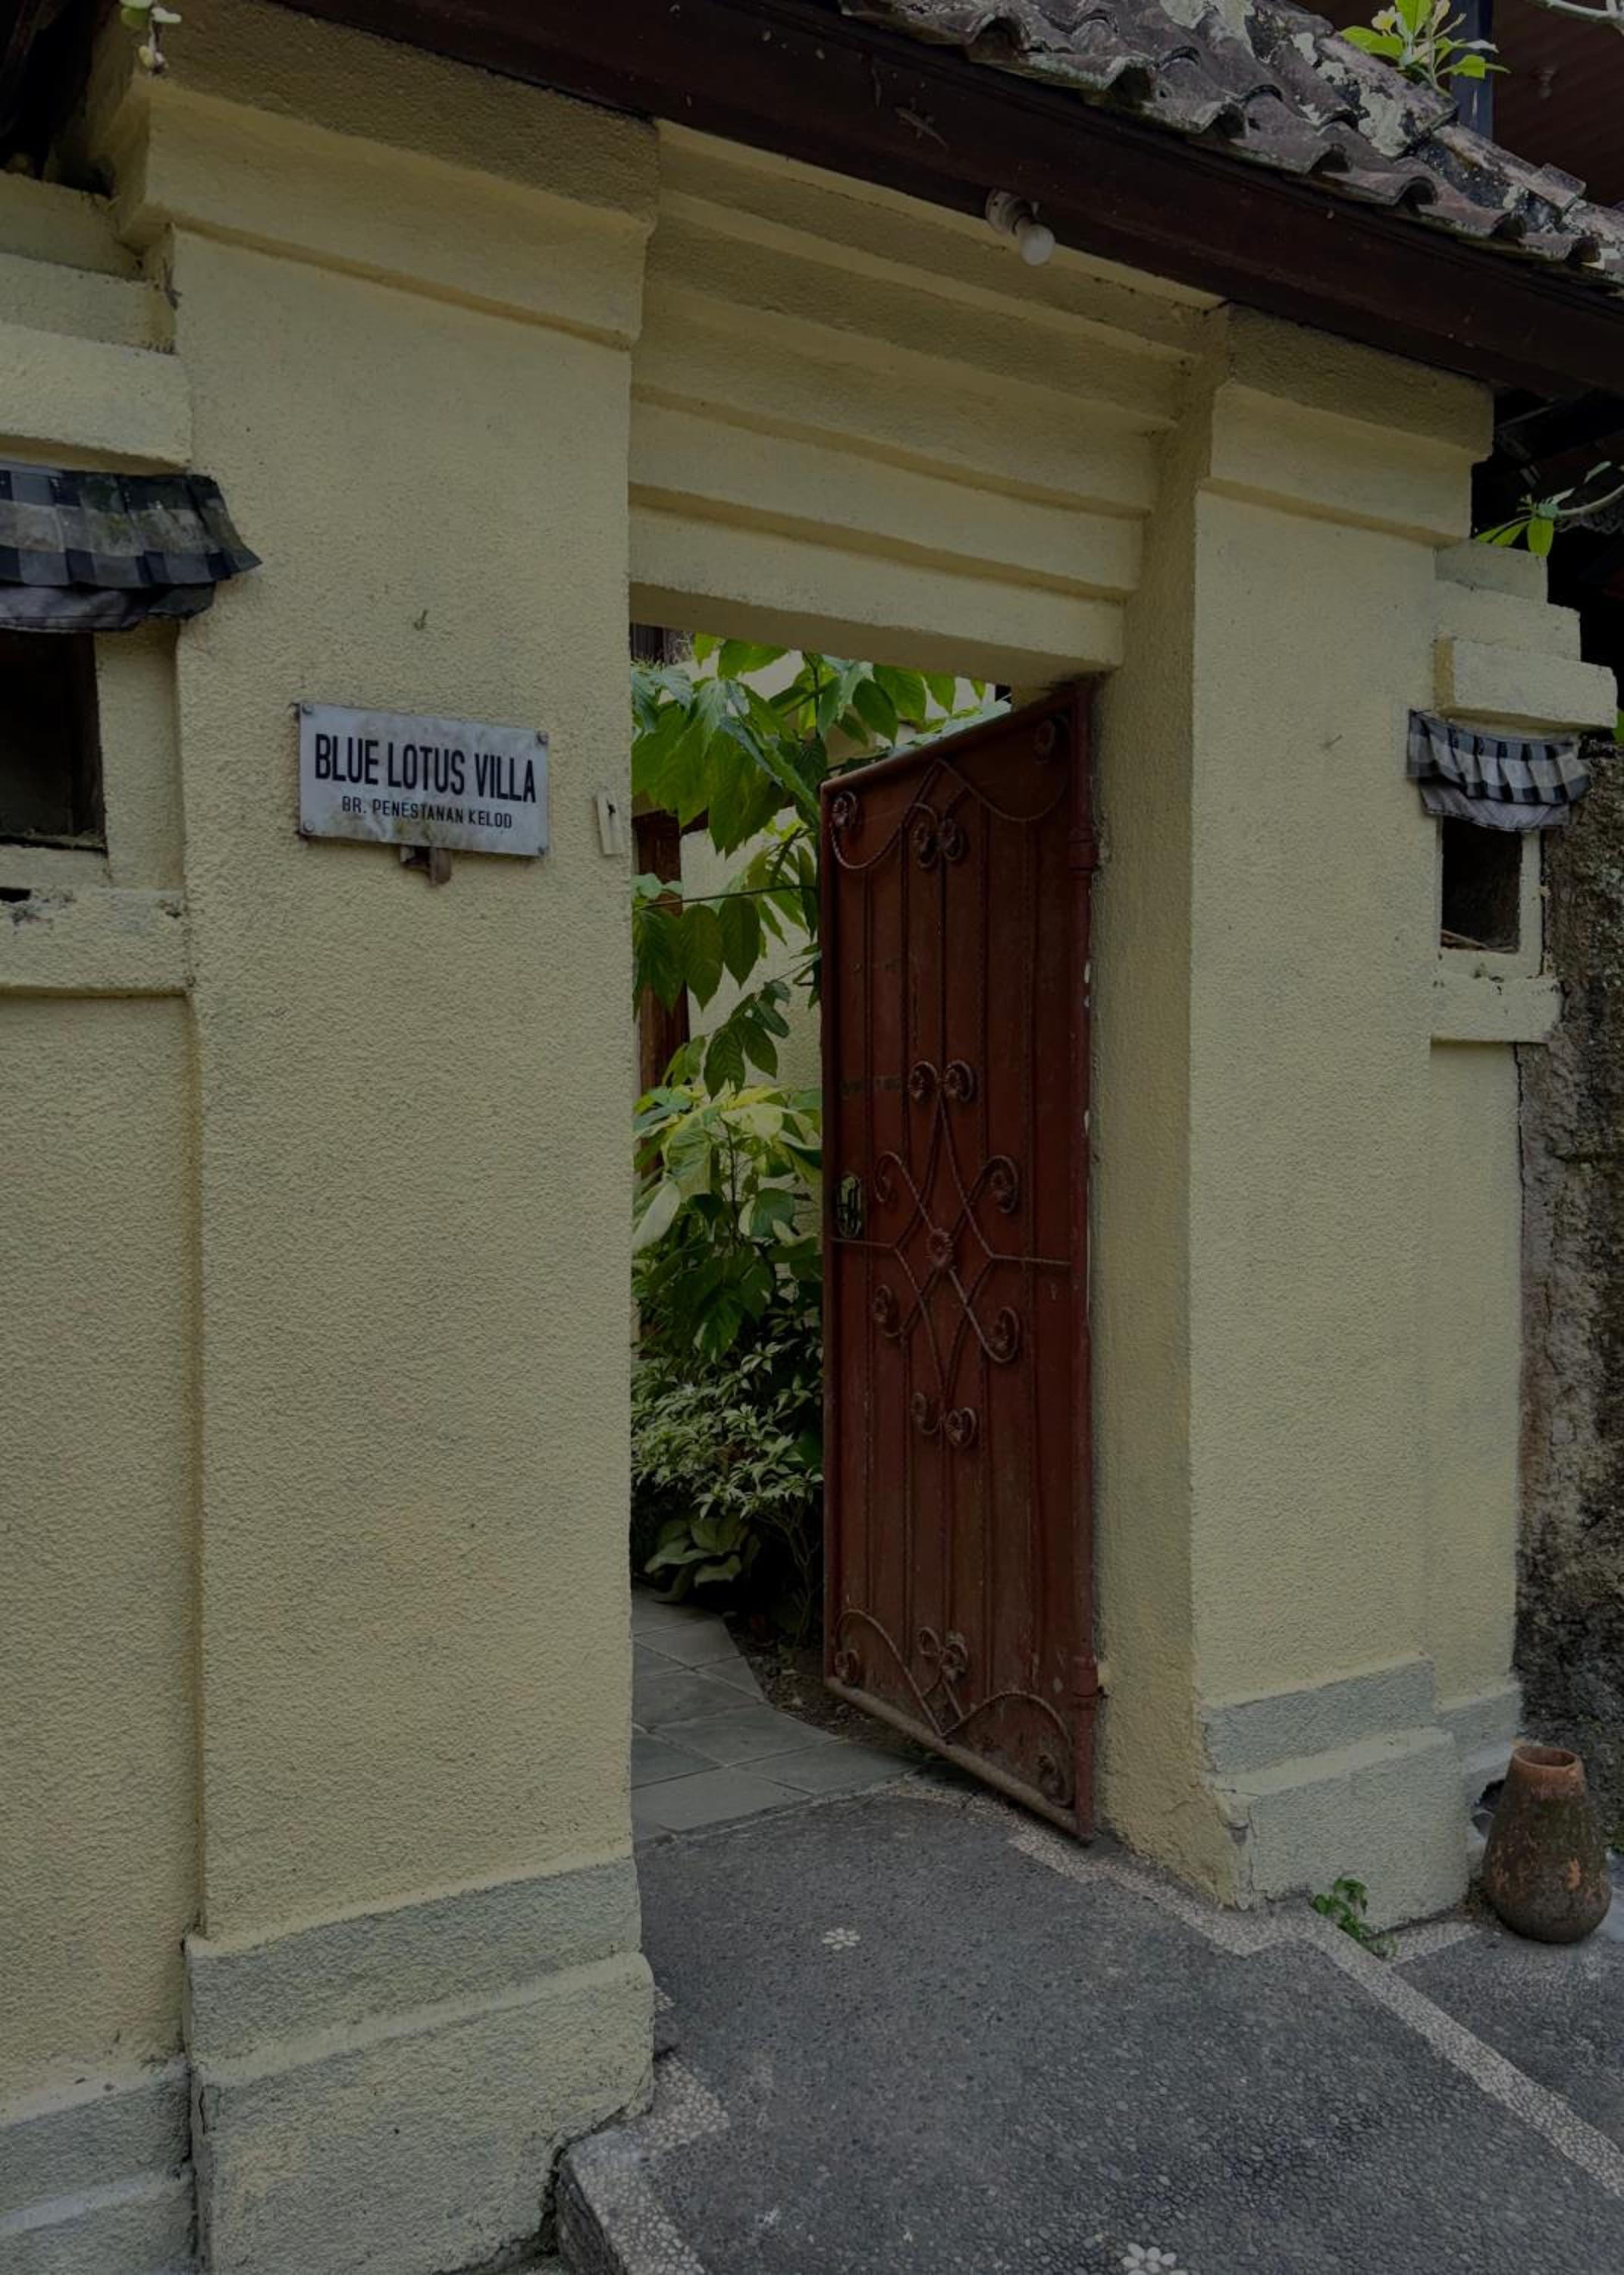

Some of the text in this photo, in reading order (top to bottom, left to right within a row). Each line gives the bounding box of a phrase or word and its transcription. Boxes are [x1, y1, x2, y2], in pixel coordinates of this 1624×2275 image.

[315, 733, 537, 803] BLUE LOTUS VILLA
[342, 795, 513, 829] BR. PENESTANAN KELOD
